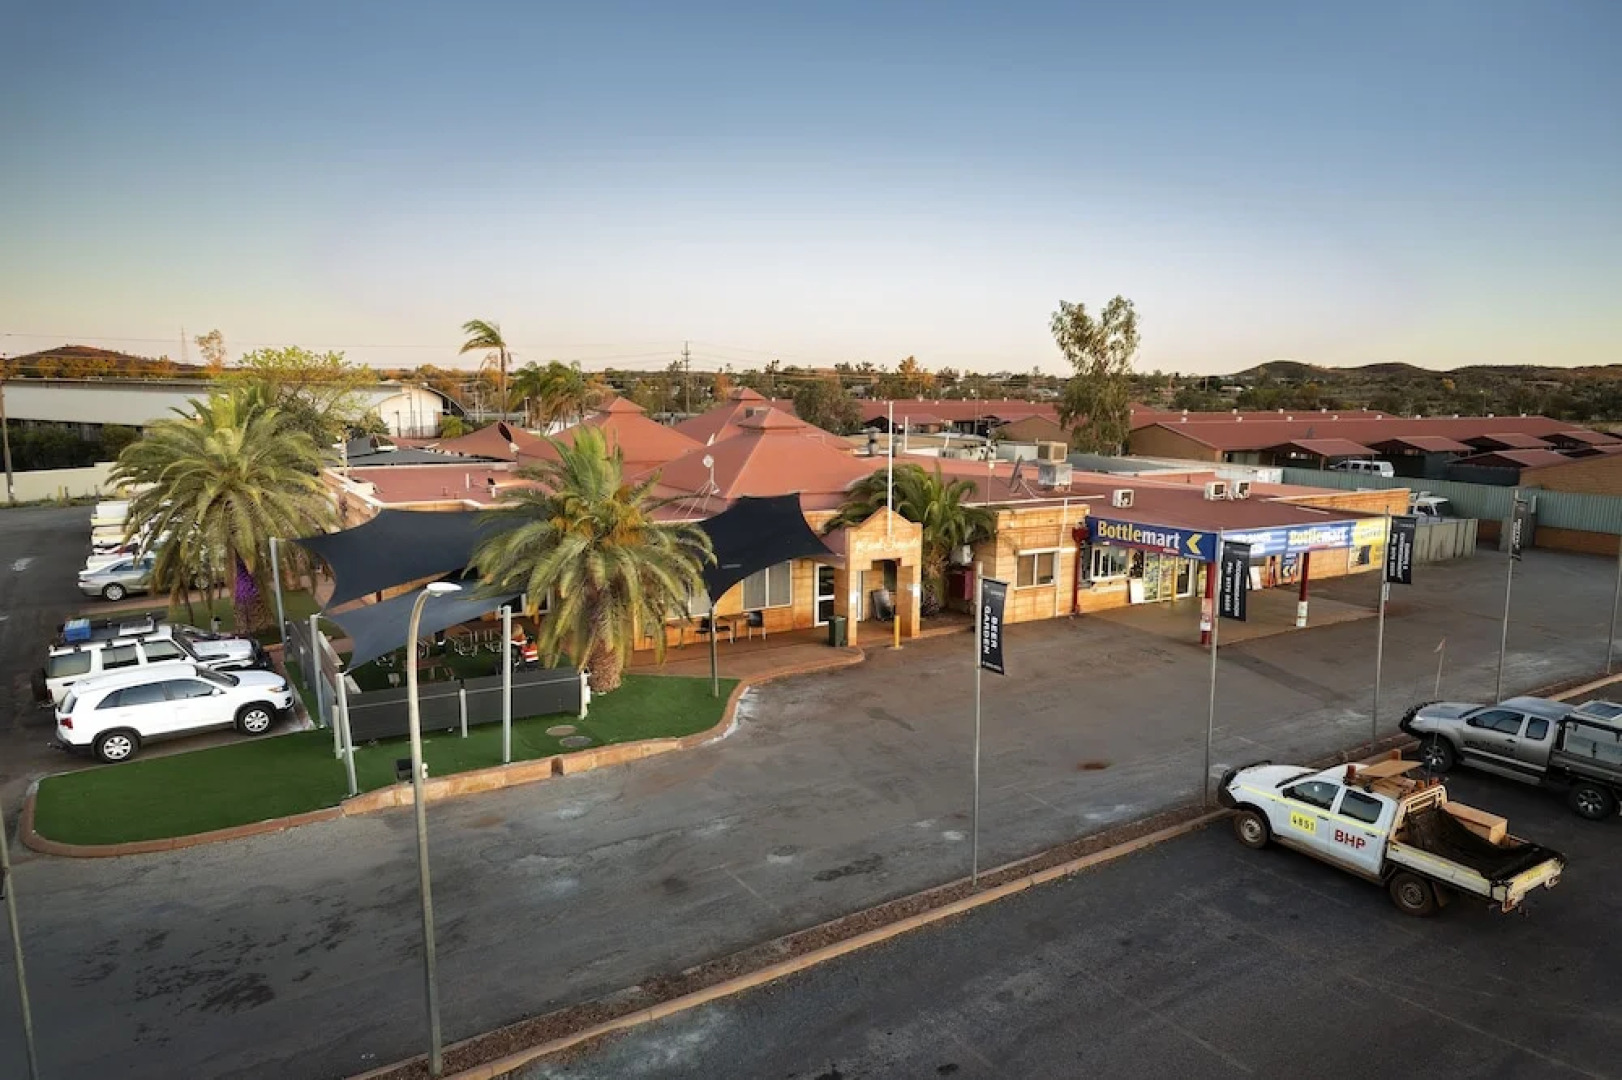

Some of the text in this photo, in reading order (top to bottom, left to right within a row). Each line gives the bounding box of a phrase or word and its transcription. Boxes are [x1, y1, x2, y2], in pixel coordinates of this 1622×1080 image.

[1097, 520, 1181, 549] Bottlemart
[983, 606, 991, 654] GARDEN
[1335, 829, 1367, 849] BHP
